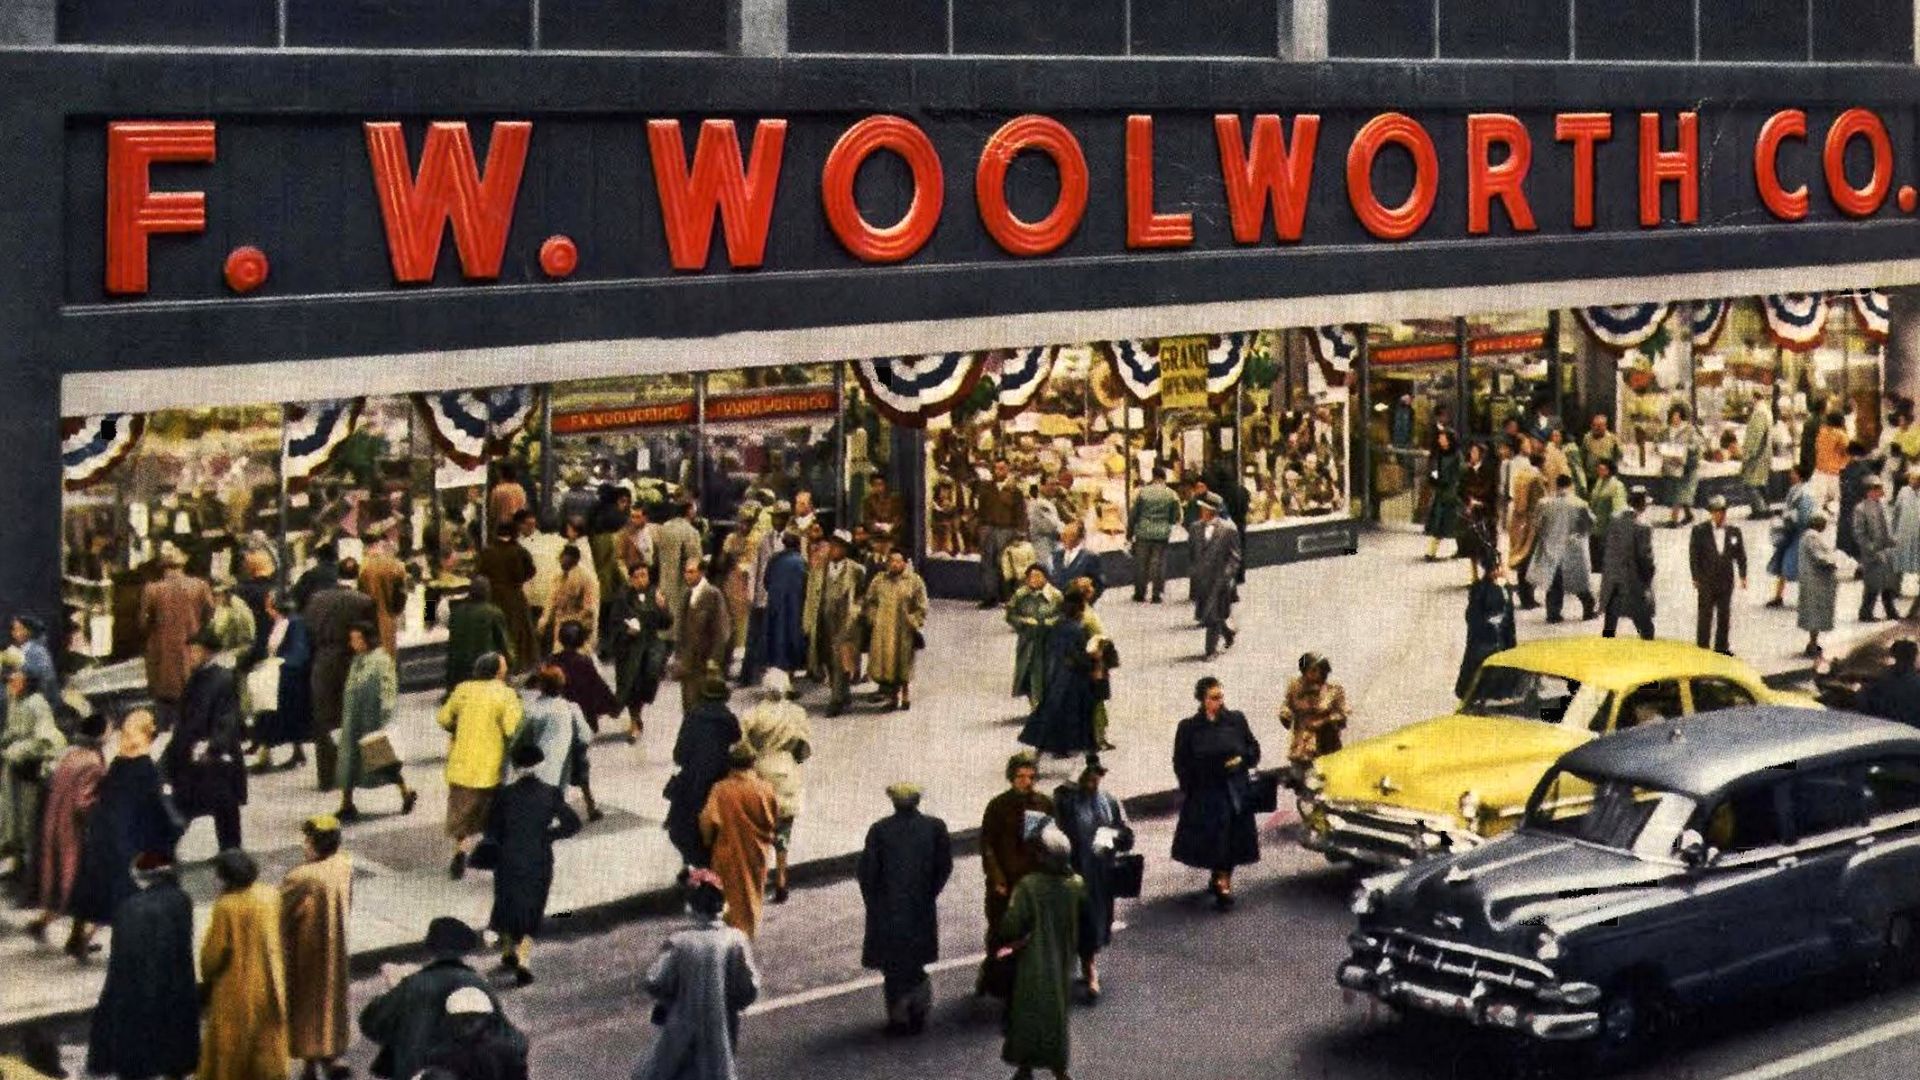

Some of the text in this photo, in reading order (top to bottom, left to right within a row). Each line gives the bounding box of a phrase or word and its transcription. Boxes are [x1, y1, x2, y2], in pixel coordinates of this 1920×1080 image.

[107, 108, 1918, 294] F. W. WOOLWORTH CO.
[1160, 343, 1208, 372] GRAND
